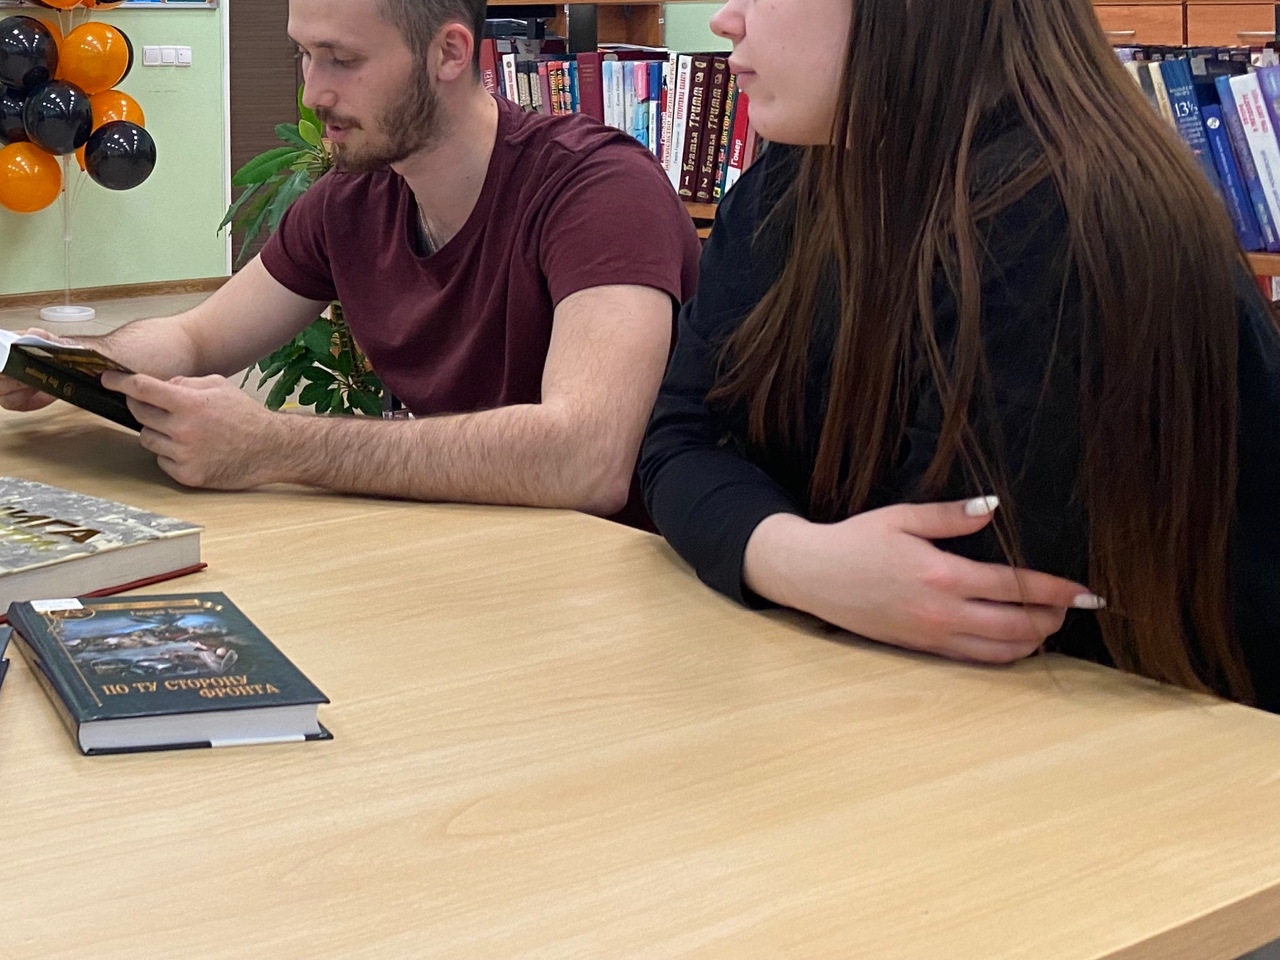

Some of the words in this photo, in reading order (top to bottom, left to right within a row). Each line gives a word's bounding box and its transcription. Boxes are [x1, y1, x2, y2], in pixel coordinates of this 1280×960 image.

[683, 132, 698, 171] Братья
[702, 134, 716, 173] Братья
[731, 139, 742, 166] Гомер
[685, 175, 689, 185] 1
[702, 178, 707, 188] 2
[101, 683, 130, 696] ПО
[132, 681, 158, 693] ТУ
[164, 675, 249, 691] СТОРОНУ
[198, 683, 281, 700] ФРОНТА
